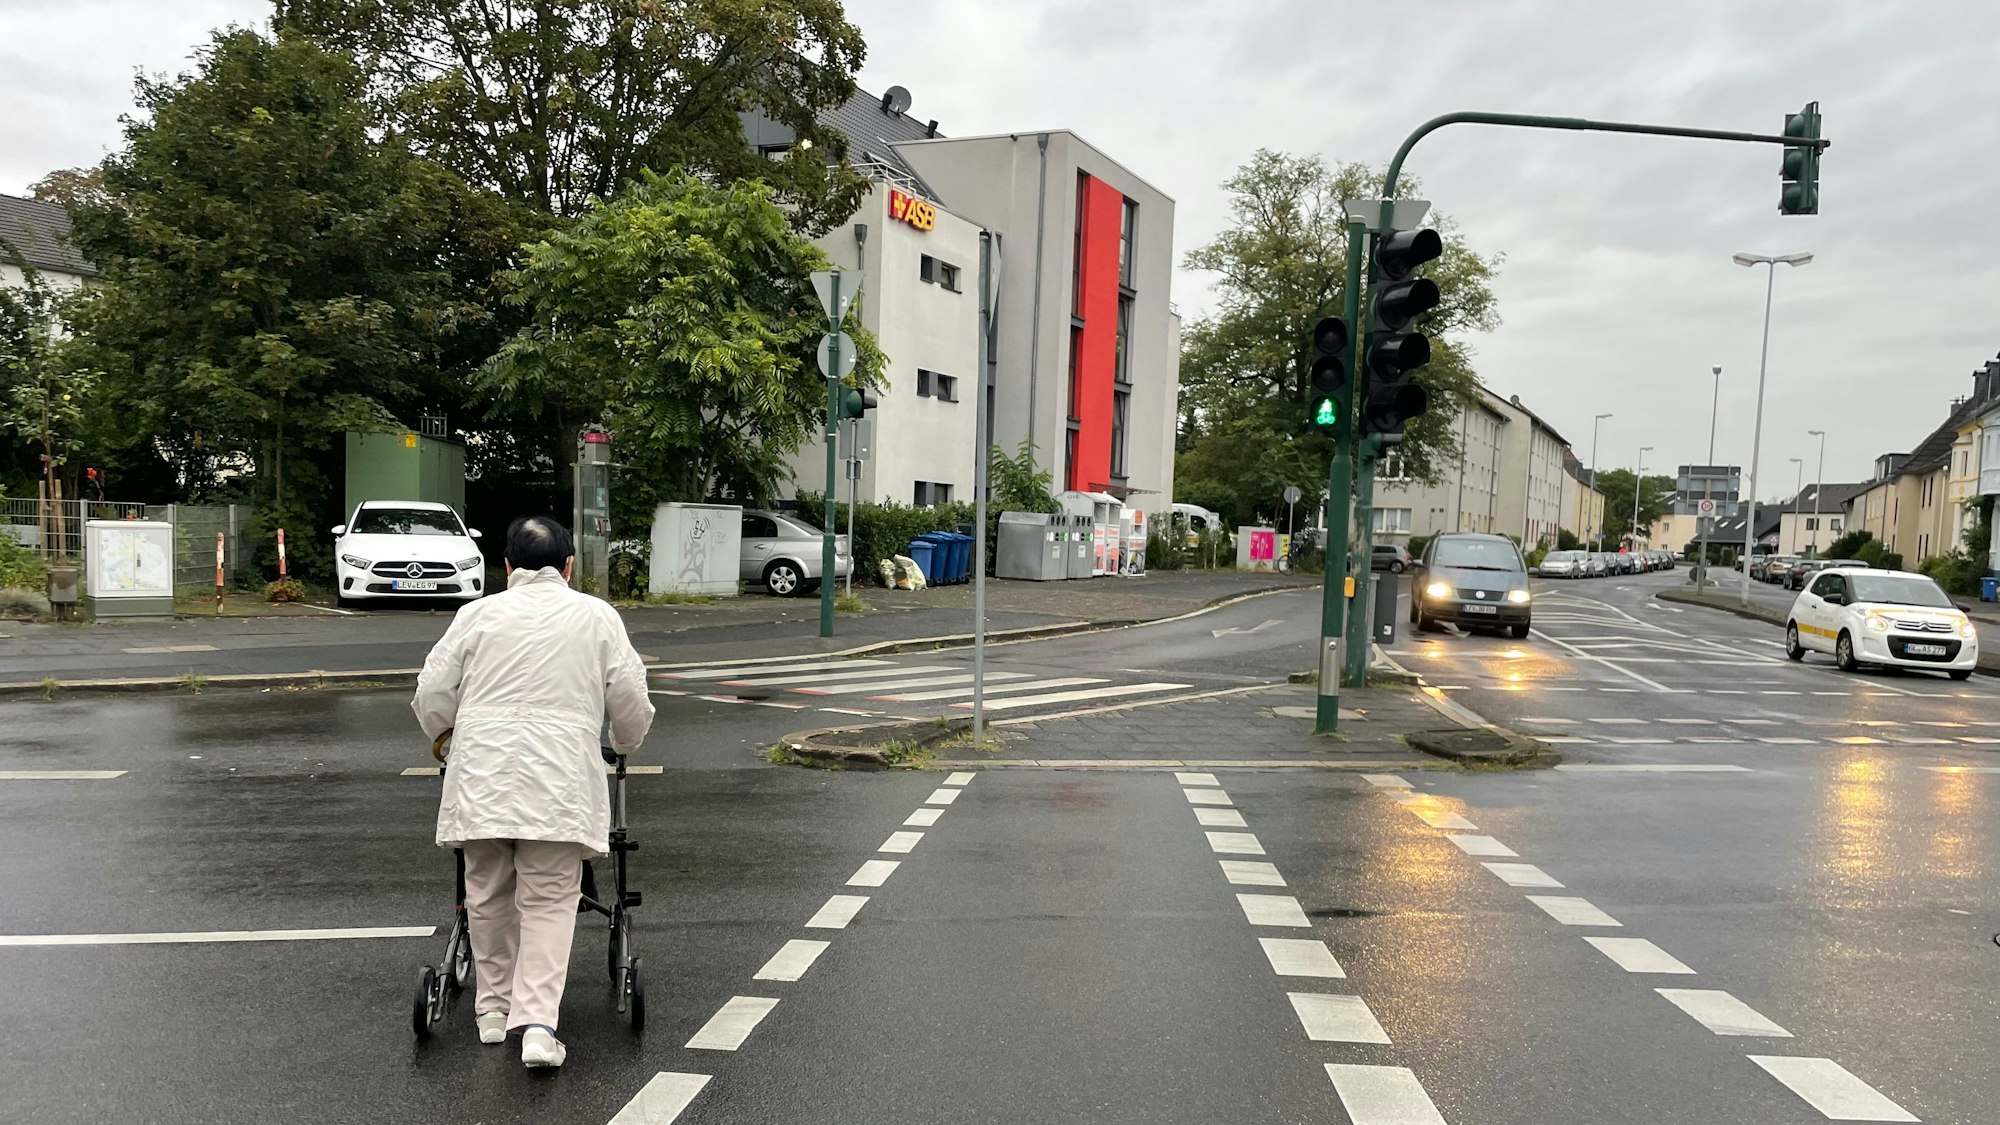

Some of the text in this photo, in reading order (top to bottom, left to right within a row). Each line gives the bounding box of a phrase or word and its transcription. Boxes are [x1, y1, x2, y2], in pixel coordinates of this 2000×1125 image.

[904, 199, 936, 232] ASB
[397, 581, 412, 589] LEV
[416, 581, 426, 589] EG
